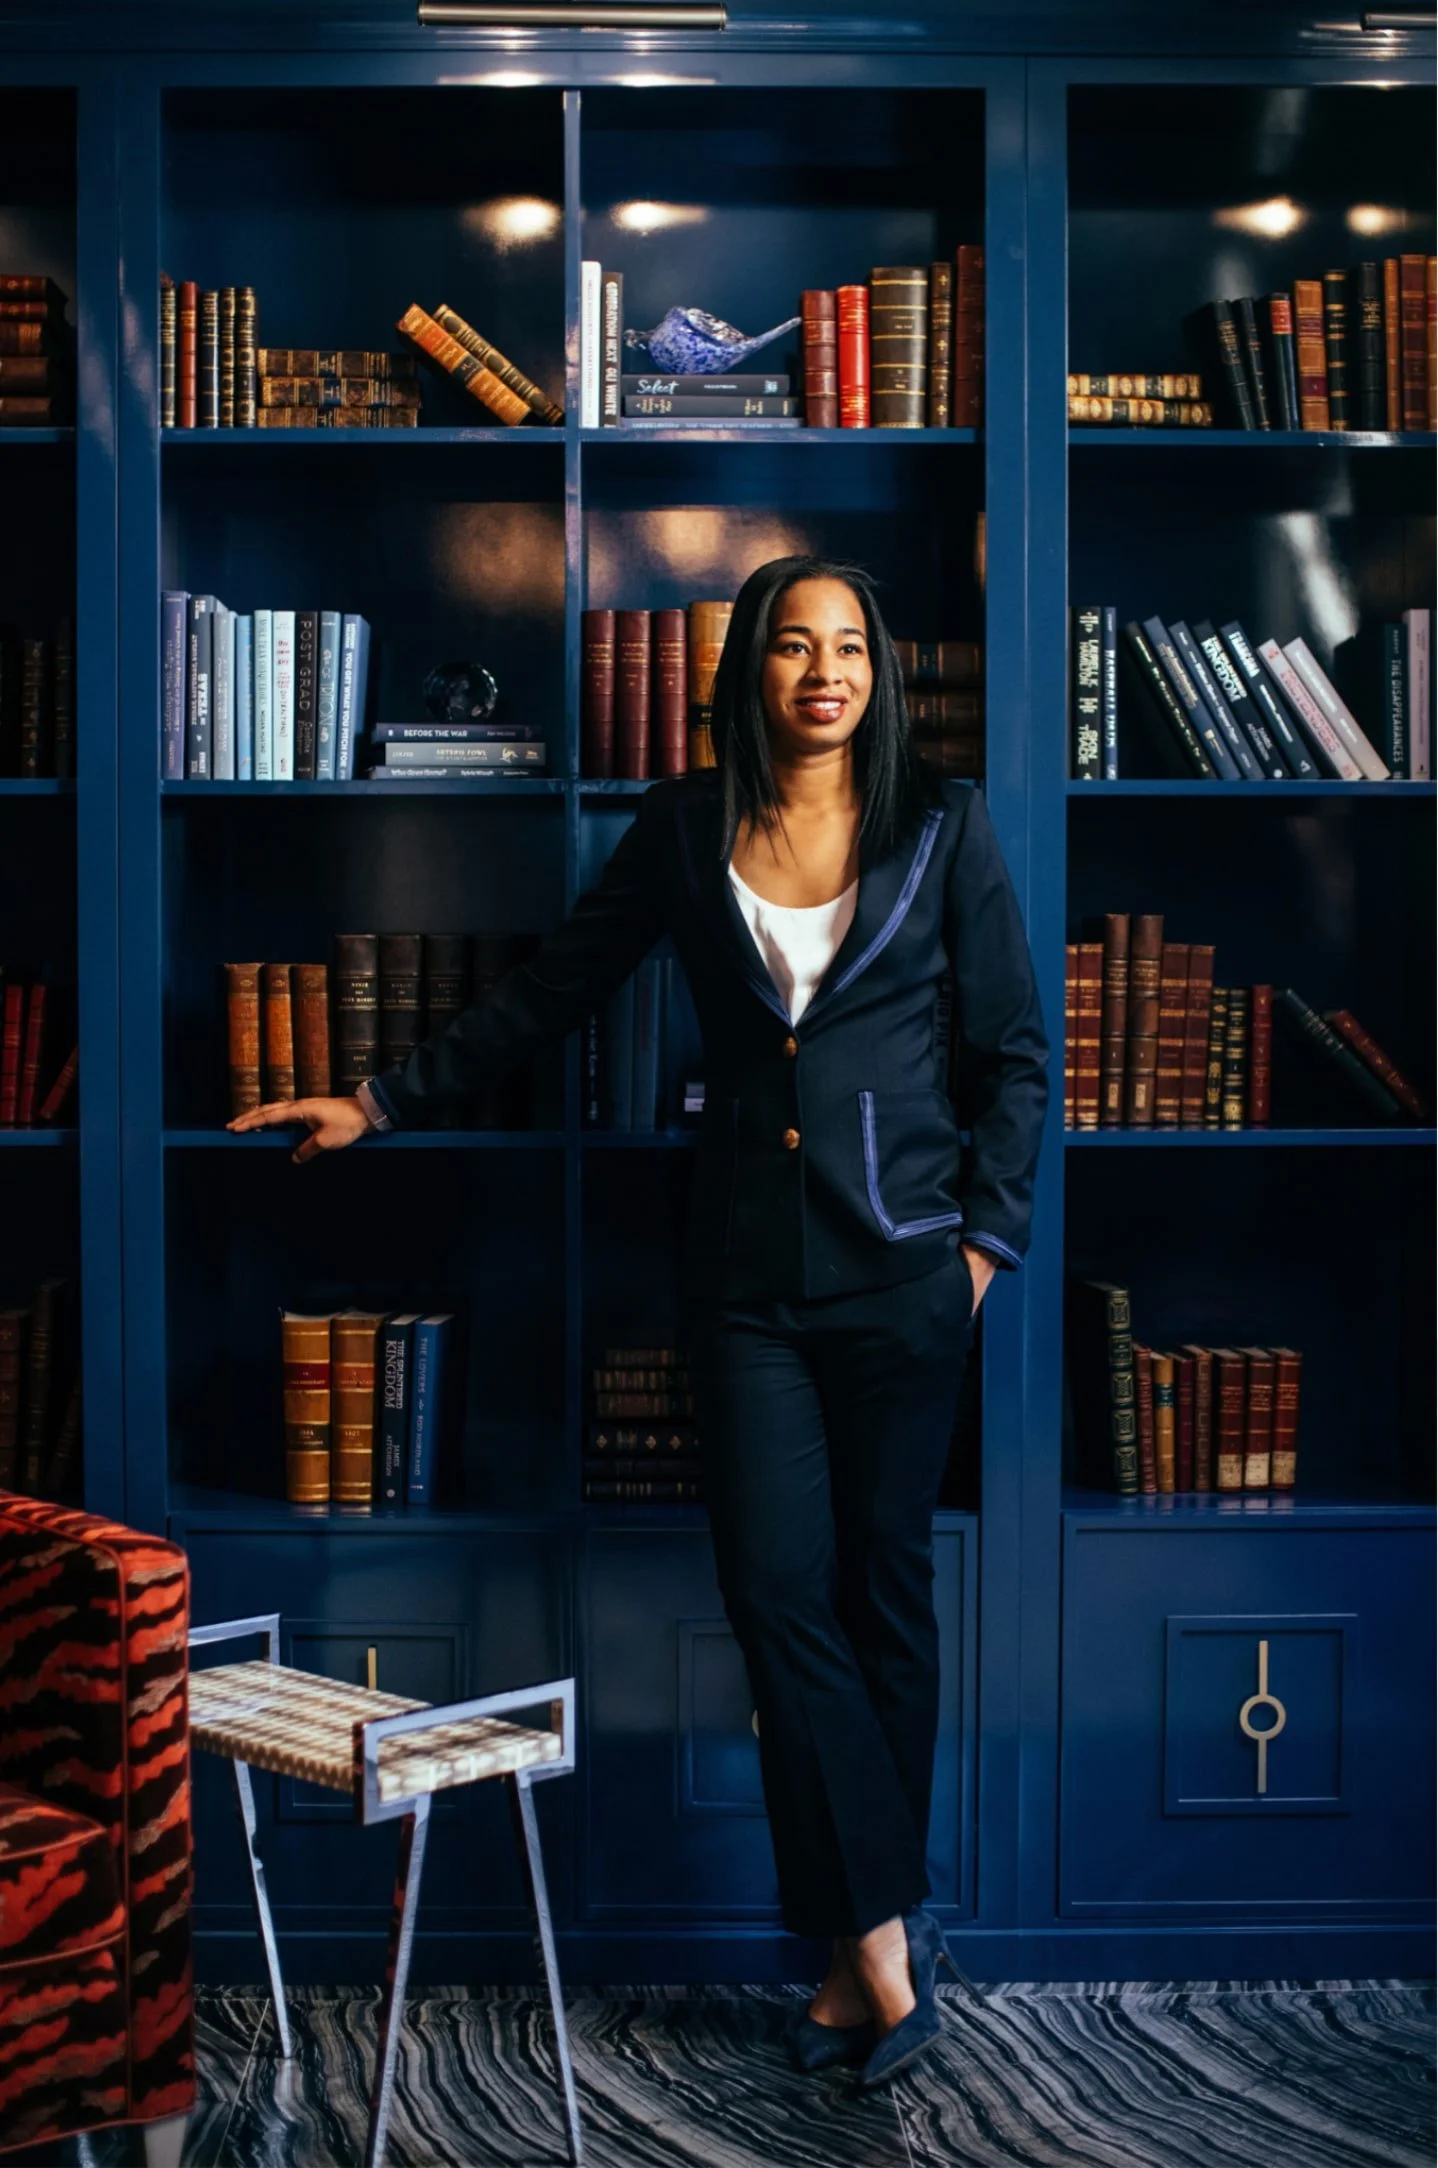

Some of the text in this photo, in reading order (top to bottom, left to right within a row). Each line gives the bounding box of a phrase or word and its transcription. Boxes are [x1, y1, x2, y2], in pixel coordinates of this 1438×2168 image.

[606, 339, 617, 362] NEXT
[605, 385, 616, 415] WHITE
[636, 379, 679, 395] Select
[299, 620, 312, 711] POST GRAD
[344, 670, 352, 685] GET
[1200, 638, 1241, 702] KINGDOM
[1391, 660, 1401, 676] THE
[198, 673, 208, 716] TEXAS
[343, 686, 351, 709] WHAT
[342, 710, 350, 727] YOU
[1391, 680, 1404, 762] DISAPPEARANCES
[341, 728, 349, 750] PITCH
[1078, 724, 1088, 765] TRADE
[1088, 730, 1098, 759] SKIN
[341, 752, 349, 767] FOR
[384, 1340, 396, 1408] KINGDOM
[396, 1340, 404, 1409] THE SPLINTERED
[418, 1337, 427, 1393] THE LOVERS
